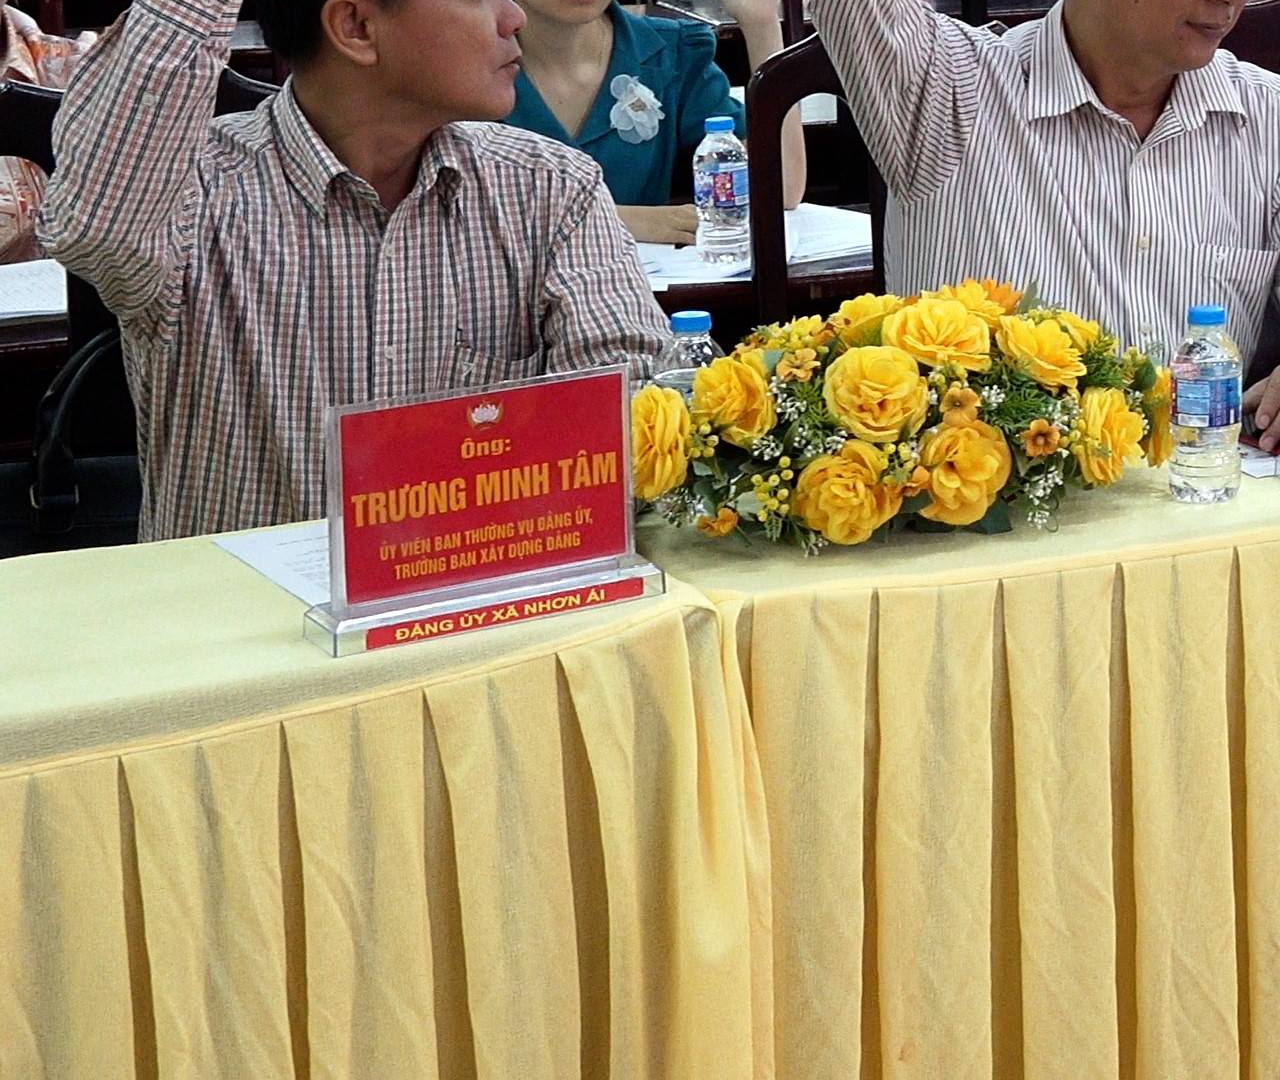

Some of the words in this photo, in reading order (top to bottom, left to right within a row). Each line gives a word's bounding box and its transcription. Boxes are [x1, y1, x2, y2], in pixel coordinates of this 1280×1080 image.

[460, 438, 512, 460] Ông:
[351, 477, 467, 528] TRƯƠNG
[476, 462, 549, 507] MINH
[558, 449, 618, 492] TÂM
[380, 540, 397, 561] ỦY
[401, 537, 430, 557] VIÊN
[435, 533, 462, 552] BAN
[465, 521, 514, 546] THƯỜNG
[518, 518, 534, 538] VỤ
[537, 509, 572, 532] ĐẢNG
[576, 505, 593, 525] ỦY,
[394, 550, 447, 580] TRƯỞNG
[451, 549, 477, 568] BAN
[480, 542, 504, 564] XÂY
[508, 538, 543, 560] DỰNG
[546, 530, 581, 551] ĐẢNG
[395, 619, 454, 641] ĐẢNG
[460, 612, 486, 628] ỦY
[492, 604, 518, 622] XÃ
[524, 594, 581, 616] NHƠN
[586, 588, 605, 604] ÁI
